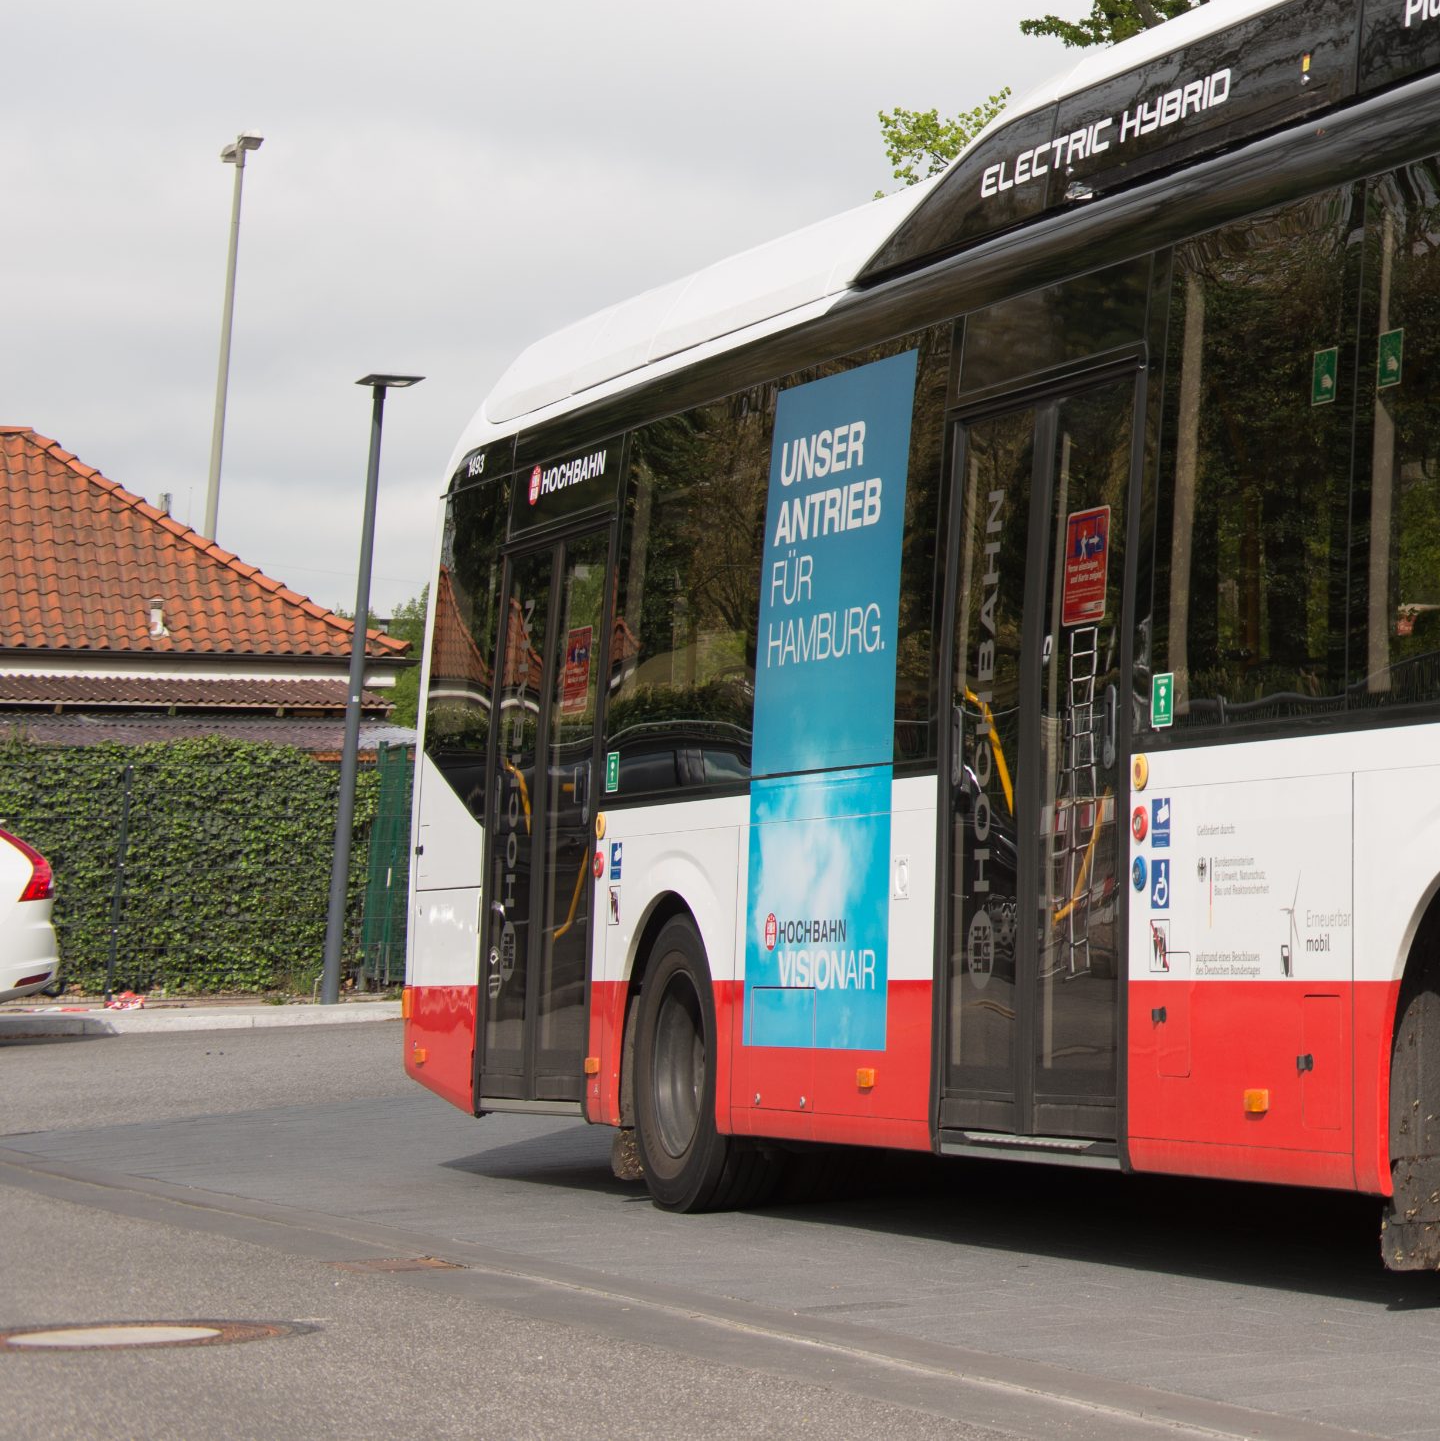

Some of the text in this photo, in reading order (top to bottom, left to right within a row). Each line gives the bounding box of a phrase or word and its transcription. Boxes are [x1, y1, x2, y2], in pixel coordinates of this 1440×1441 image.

[981, 69, 1231, 198] ELECTRIC HYBRID
[467, 454, 485, 478] 1493
[540, 450, 606, 495] HOCHBAHN
[781, 420, 866, 487] UNSER
[773, 477, 882, 547] ANTRIEB
[771, 549, 813, 607] FÜR
[767, 603, 885, 668] HAMBURG.
[974, 488, 1005, 892] HOCHBAHN
[778, 919, 847, 944] HOCHBAHN
[1307, 910, 1351, 927] Erneuerbar
[1307, 934, 1330, 952] mobil
[778, 949, 876, 990] VISIONAIR
